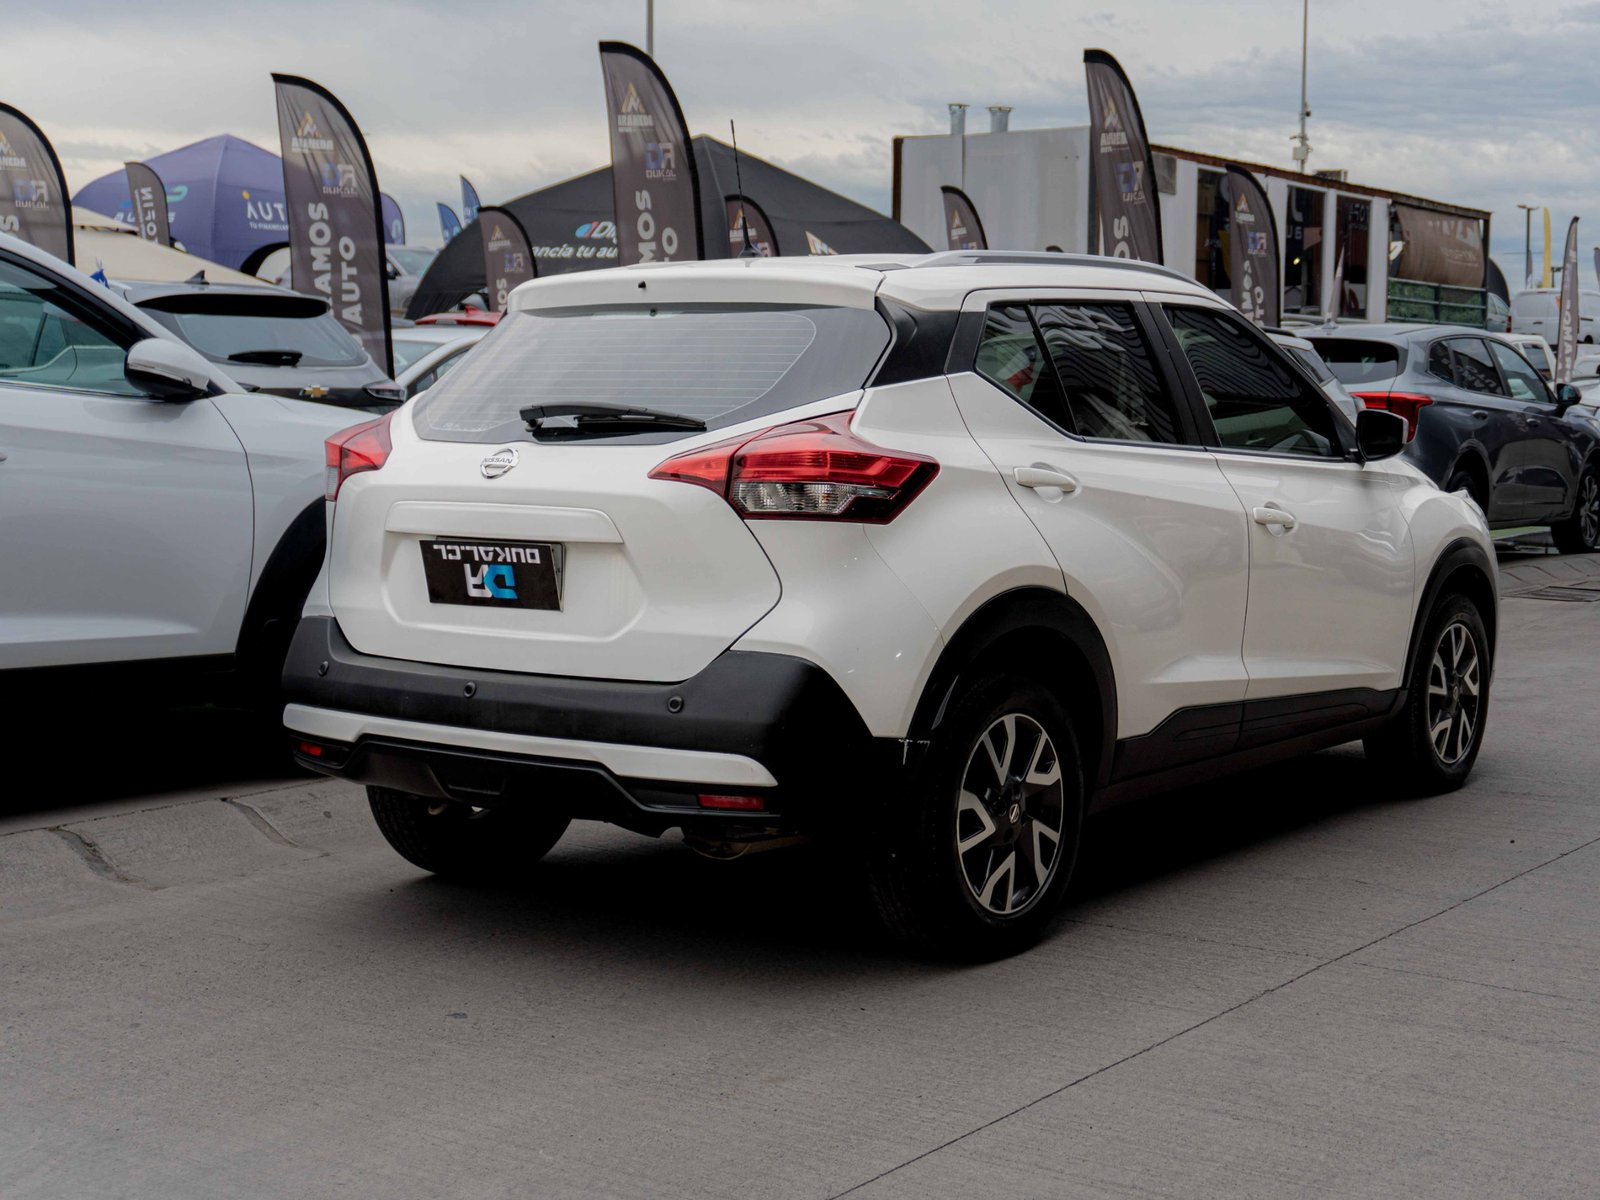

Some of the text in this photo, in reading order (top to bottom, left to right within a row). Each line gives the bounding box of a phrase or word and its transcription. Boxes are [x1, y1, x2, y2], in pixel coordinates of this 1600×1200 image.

[308, 202, 334, 312] AMOS
[576, 245, 597, 258] tu
[338, 236, 363, 326] AUTO
[433, 544, 541, 564] DUKAL.CL
